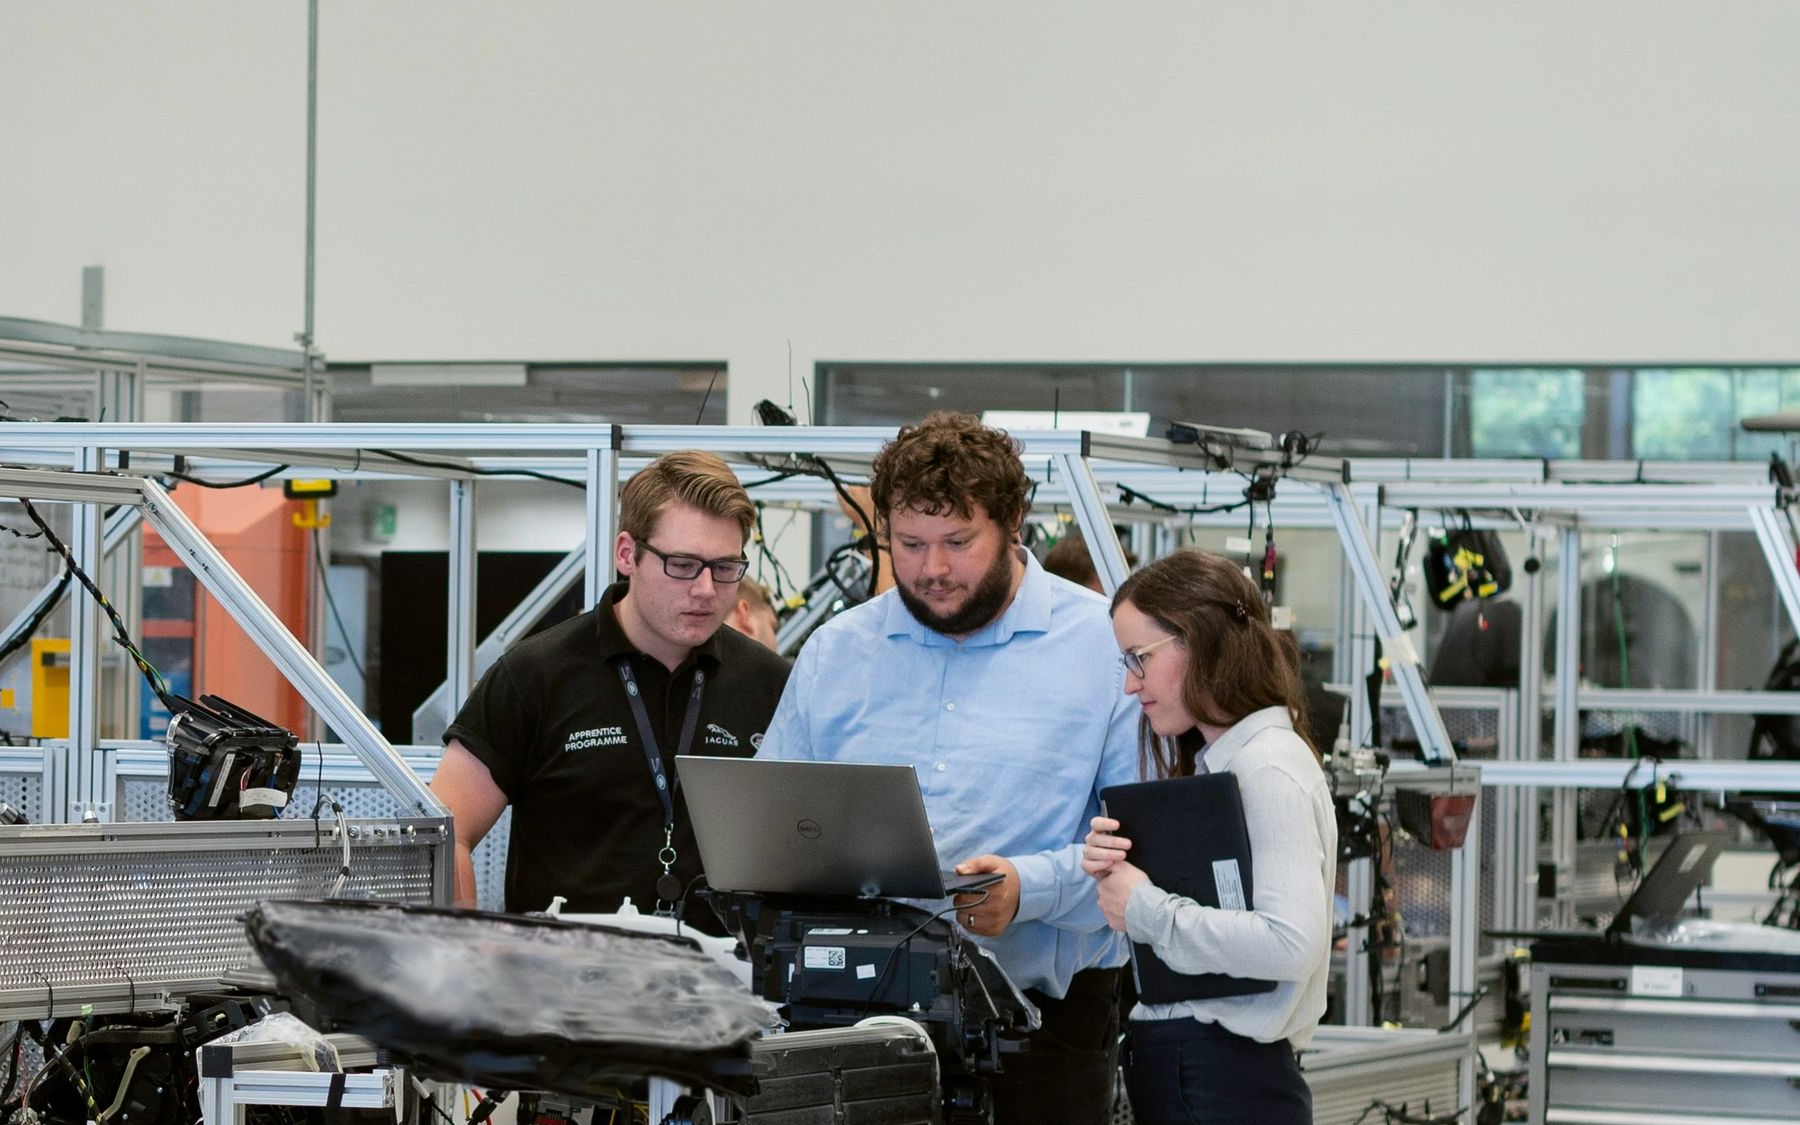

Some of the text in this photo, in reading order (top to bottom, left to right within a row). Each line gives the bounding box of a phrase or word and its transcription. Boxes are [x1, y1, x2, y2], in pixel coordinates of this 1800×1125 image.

[568, 726, 623, 742] APPRENTICE
[704, 736, 739, 747] JAGUAR
[564, 735, 628, 752] PROGRAMME
